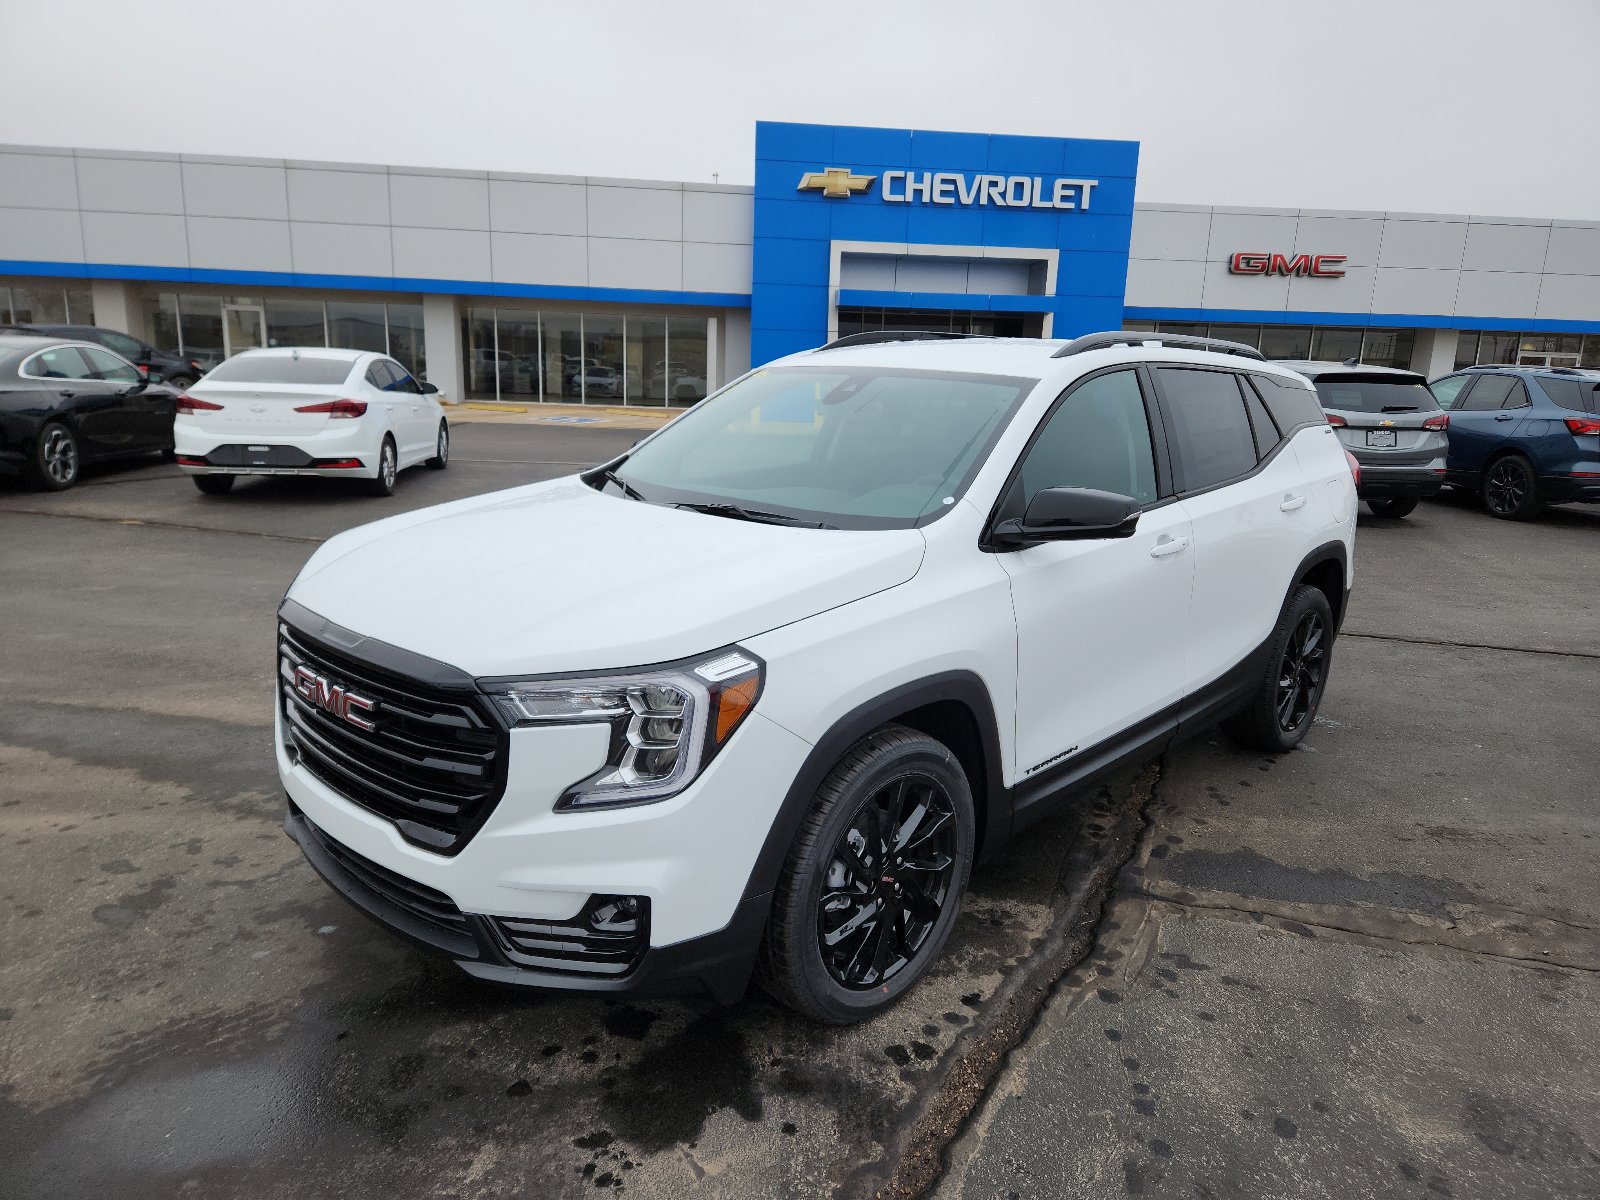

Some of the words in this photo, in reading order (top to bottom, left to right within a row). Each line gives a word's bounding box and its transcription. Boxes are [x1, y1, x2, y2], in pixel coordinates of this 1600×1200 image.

[882, 170, 1099, 210] CHEVROLET
[1230, 251, 1347, 278] GMC
[294, 665, 375, 732] GMC
[1024, 745, 1079, 775] TERRAIN
